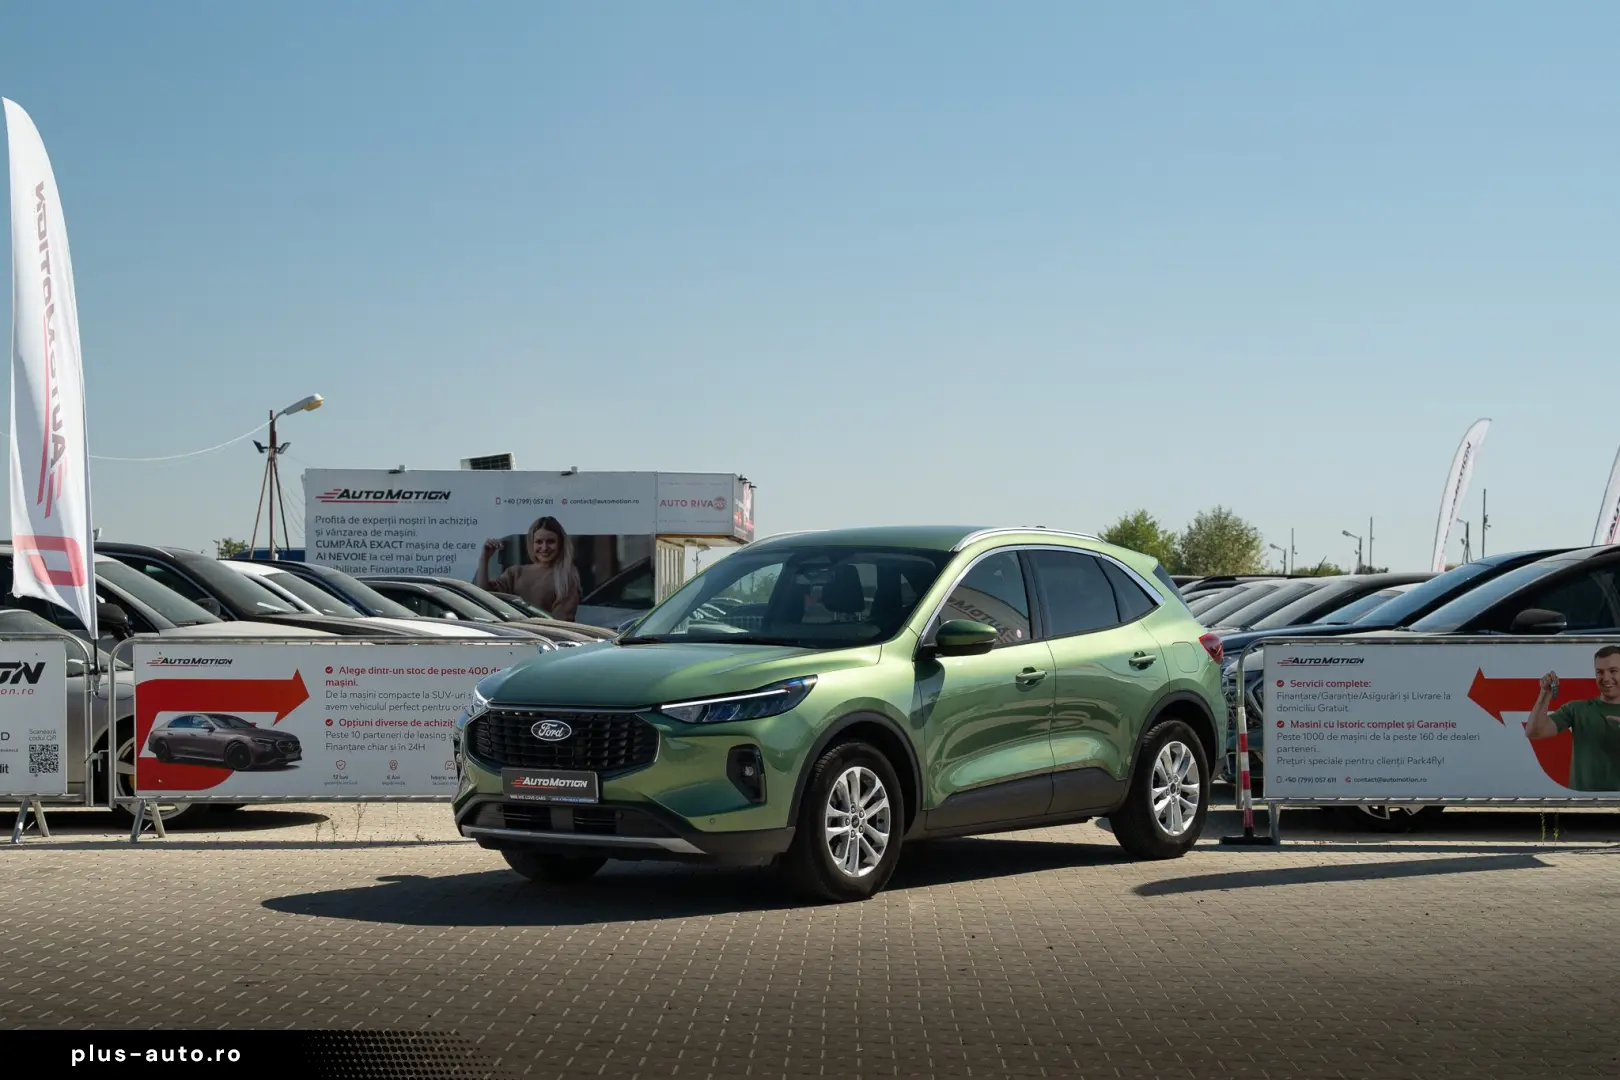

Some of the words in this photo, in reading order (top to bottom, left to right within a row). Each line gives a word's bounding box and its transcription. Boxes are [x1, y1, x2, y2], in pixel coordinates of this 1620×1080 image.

[660, 500, 688, 508] AUTO
[691, 500, 714, 508] RIVA
[347, 516, 360, 525] de
[428, 516, 437, 525] în
[315, 529, 324, 538] și
[371, 529, 382, 537] de
[316, 539, 368, 548] CUMPĂRĂ
[370, 540, 404, 549] EXACT
[442, 541, 454, 550] de
[316, 552, 326, 561] AI
[329, 552, 367, 561] NEVOIE
[380, 553, 394, 561] cel
[396, 553, 413, 562] mai
[416, 553, 434, 562] bun
[370, 564, 414, 575] Finanțare
[339, 666, 366, 677] Alege
[368, 667, 405, 675] dintr-un
[428, 667, 439, 675] de
[441, 668, 466, 677] peste
[468, 667, 489, 675] 400
[326, 679, 358, 688] mașini.
[1290, 680, 1324, 689] Servicii
[1326, 680, 1372, 690] complete:
[326, 690, 339, 699] De
[340, 690, 348, 699] la
[378, 692, 421, 701] compacte
[423, 691, 430, 699] la
[432, 691, 466, 700] SUV-uri
[1403, 692, 1410, 703] și
[1411, 692, 1442, 700] Livrare
[1444, 692, 1451, 700] la
[350, 702, 387, 711] vehiculul
[389, 702, 420, 712] perfect
[422, 704, 451, 713] pentru
[1277, 704, 1316, 713] domiciliu
[339, 719, 373, 729] Opțiuni
[375, 719, 409, 727] diverse
[410, 719, 421, 727] de
[1367, 720, 1405, 730] complet
[1407, 720, 1415, 730] și
[1417, 720, 1457, 730] Garanție
[538, 722, 564, 737] Ford
[326, 731, 349, 739] Peste
[351, 731, 361, 739] 10
[363, 731, 402, 741] parteneri
[404, 730, 415, 739] de
[418, 731, 447, 742] leasing
[1277, 732, 1301, 741] Peste
[1302, 732, 1325, 741] 1000
[1327, 733, 1339, 741] de
[1370, 732, 1381, 741] de
[1383, 732, 1392, 741] la
[1393, 733, 1418, 742] peste
[1420, 732, 1435, 741] 160
[1437, 732, 1448, 741] de
[1450, 733, 1480, 741] dealeri
[368, 743, 388, 751] chiar
[408, 743, 426, 751] 24H
[1277, 757, 1306, 768] Prețuri
[1309, 757, 1343, 767] speciale
[1345, 757, 1375, 767] pentru
[522, 776, 588, 788] AUTOMOTION
